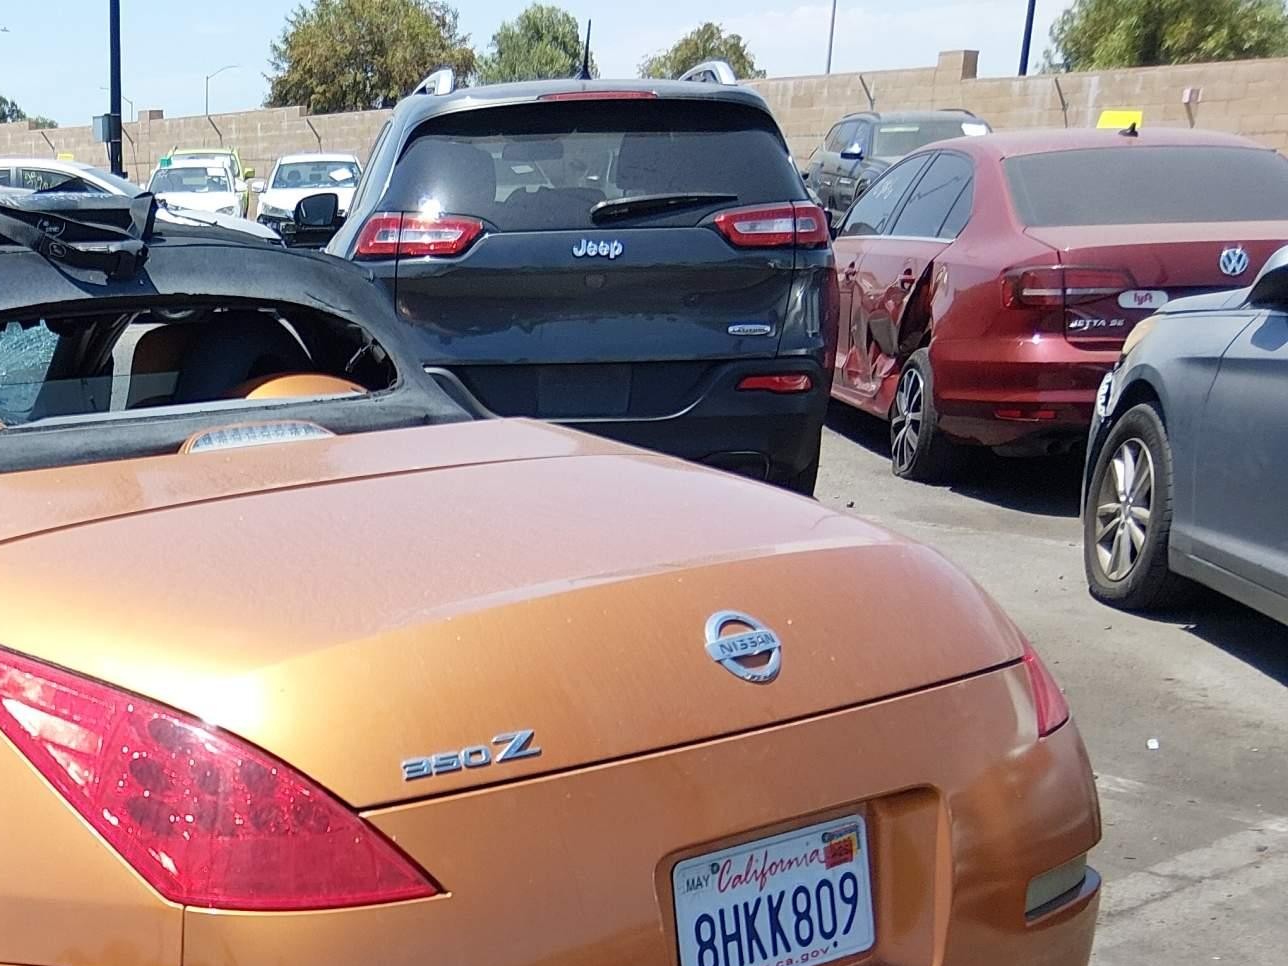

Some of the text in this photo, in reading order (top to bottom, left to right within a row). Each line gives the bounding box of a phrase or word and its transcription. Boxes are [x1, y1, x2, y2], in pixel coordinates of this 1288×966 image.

[572, 239, 623, 259] Jeep
[1133, 292, 1153, 305] lyft
[1068, 319, 1106, 332] JETTA
[718, 632, 777, 655] NISSAN
[401, 729, 543, 782] 350Z
[716, 841, 825, 893] California
[686, 873, 710, 893] MAY
